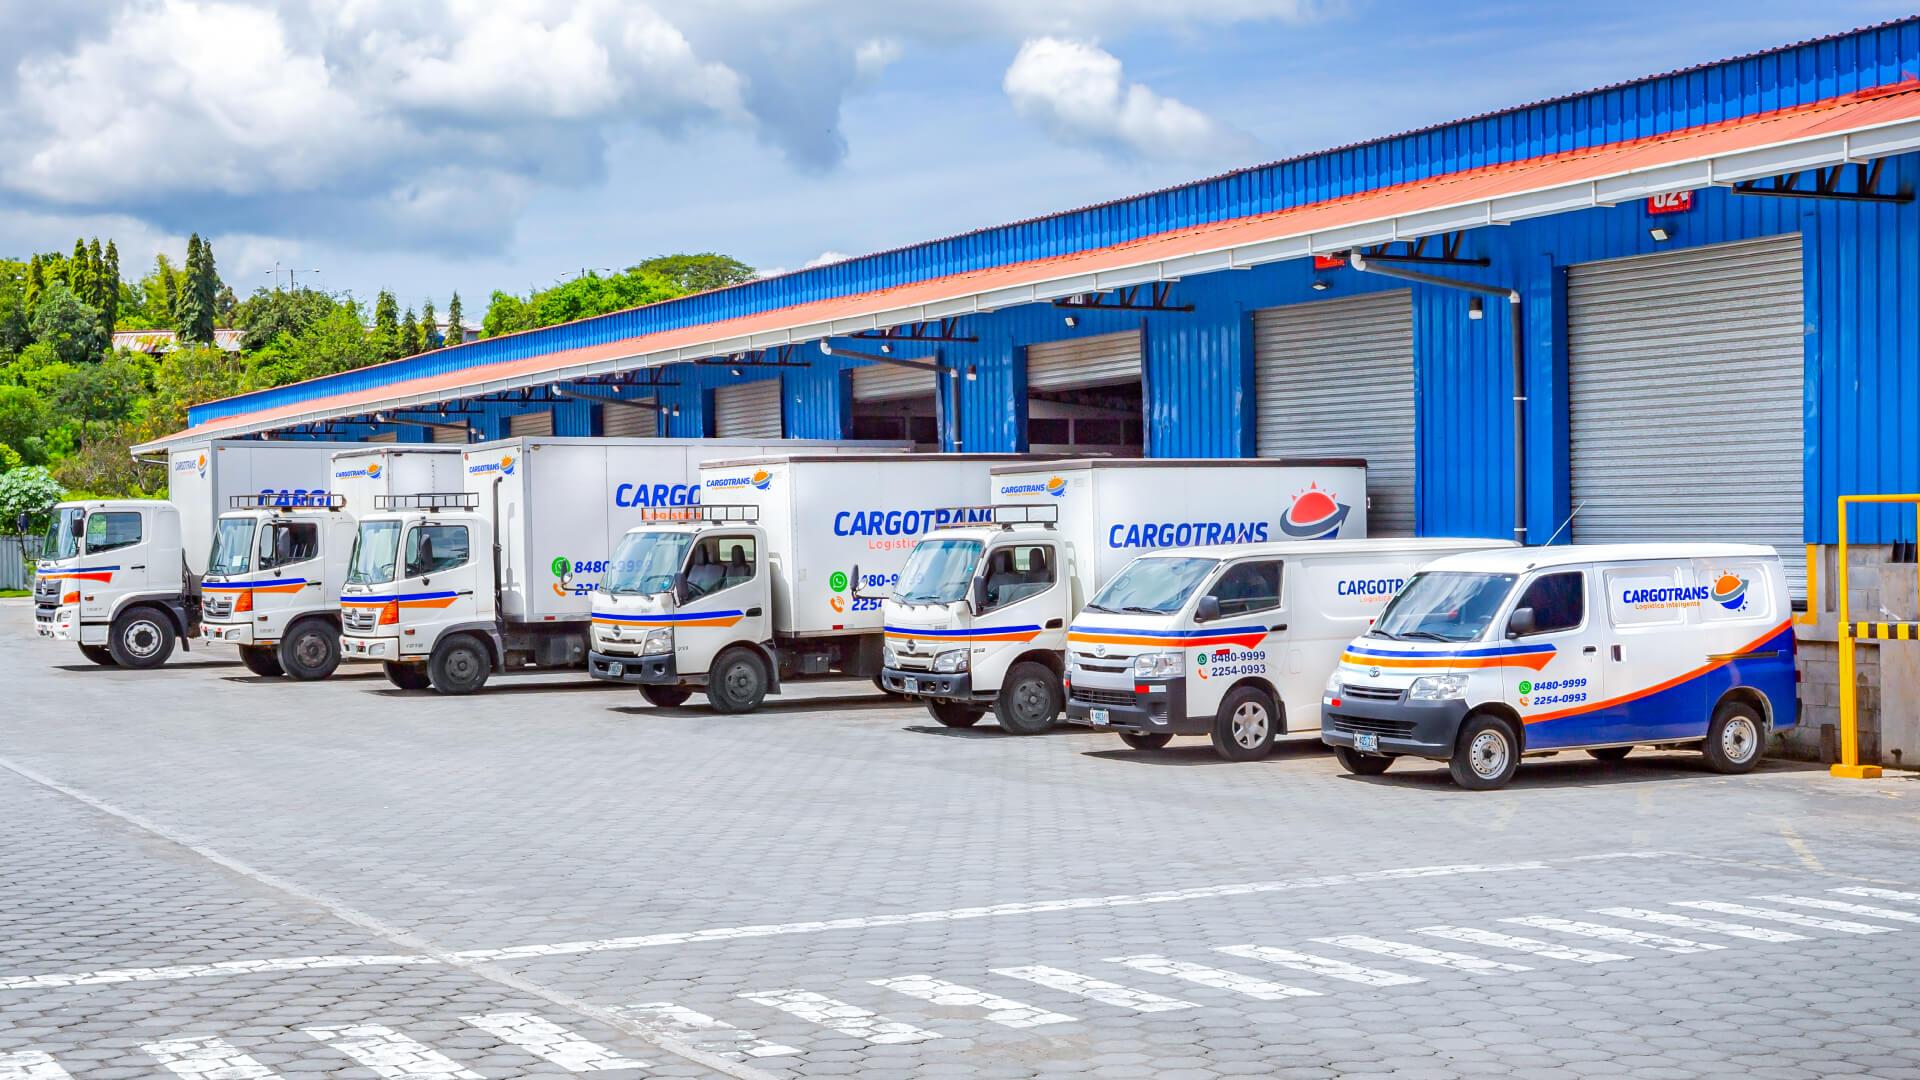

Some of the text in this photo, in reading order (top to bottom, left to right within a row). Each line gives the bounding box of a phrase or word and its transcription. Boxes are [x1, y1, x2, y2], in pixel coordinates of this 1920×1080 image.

[706, 477, 751, 488] CARGOTRANS
[1001, 484, 1045, 494] CARGOTRANS
[1109, 522, 1269, 549] CARGOTRANS
[1623, 586, 1709, 603] CARGOTRANS
[1211, 651, 1266, 663] 8480-9999
[1212, 664, 1266, 676] 2254-0993
[1534, 678, 1587, 691] 8480-9999
[1534, 692, 1587, 705] 2254-0993
